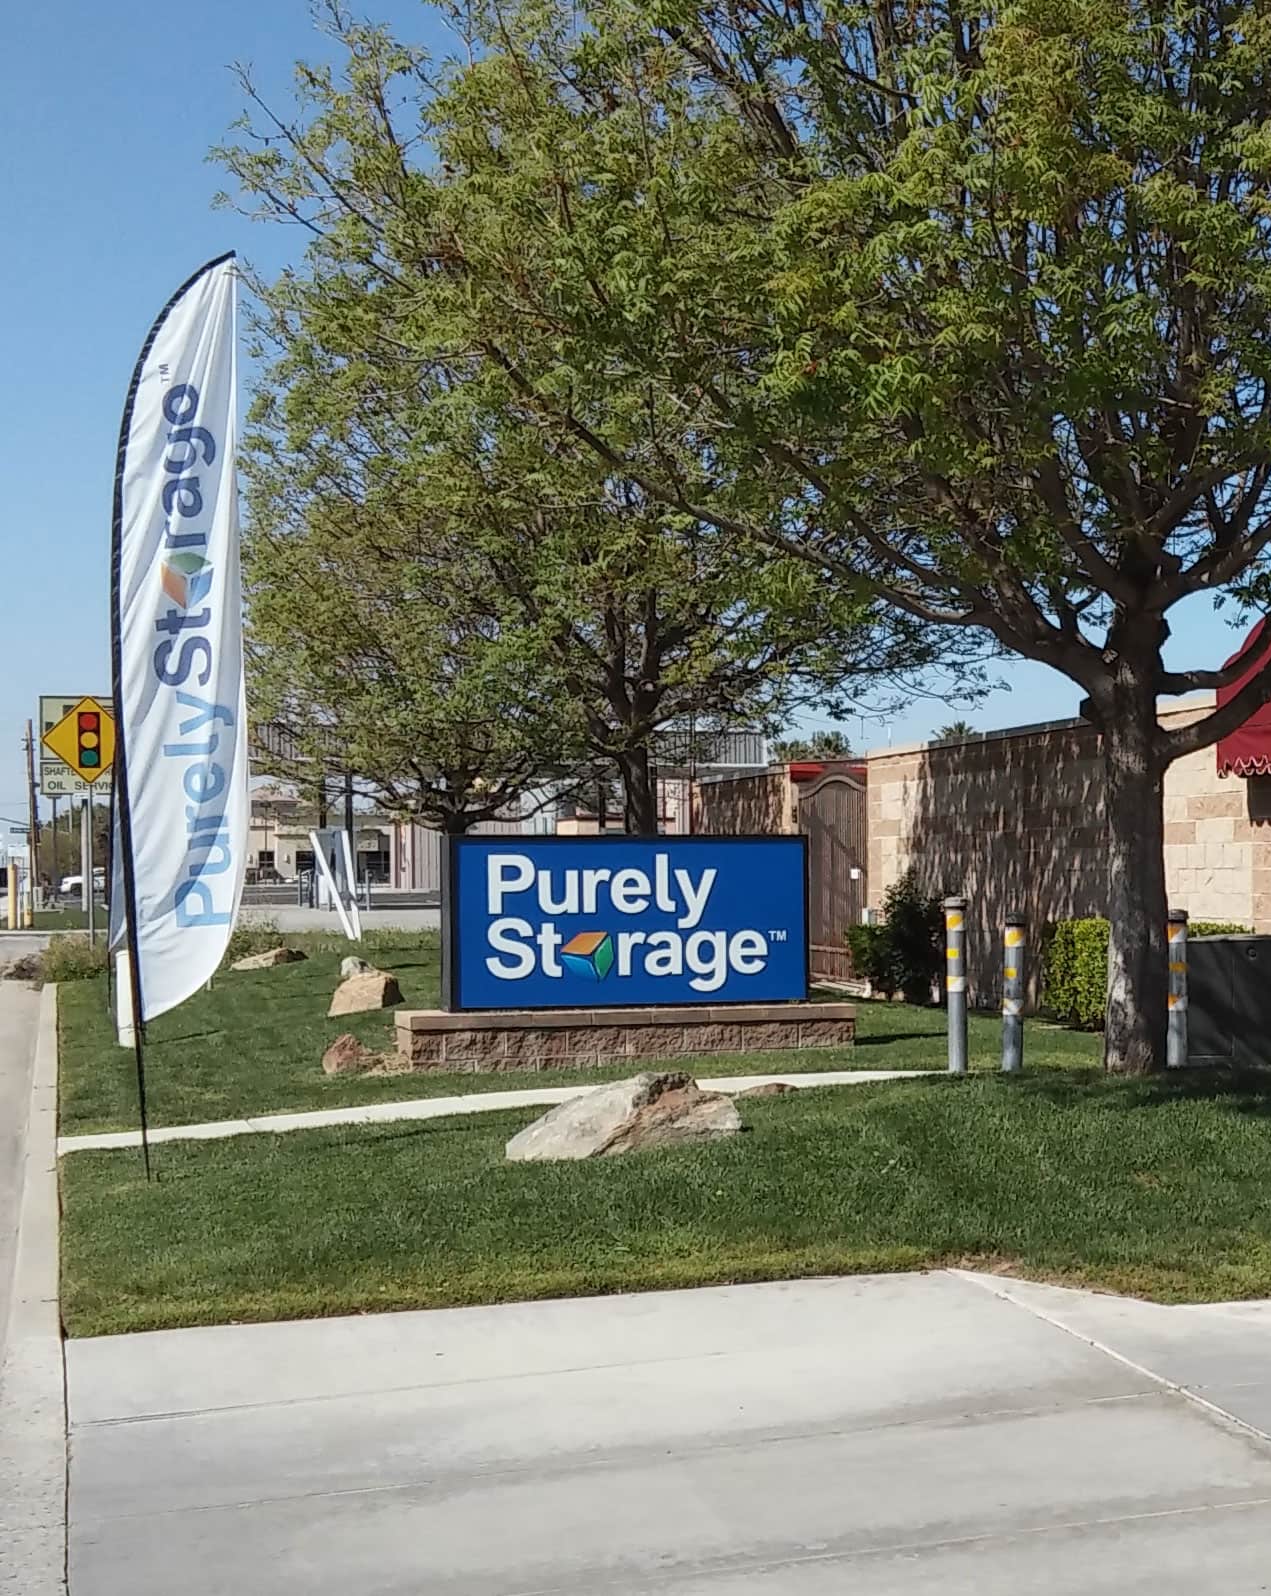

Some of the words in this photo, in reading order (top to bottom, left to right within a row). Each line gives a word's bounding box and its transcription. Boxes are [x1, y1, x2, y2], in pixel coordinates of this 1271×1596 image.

[44, 766, 77, 776] SHAFTE
[47, 780, 67, 790] OIL
[163, 691, 234, 928] Purely
[487, 853, 717, 929] Purely
